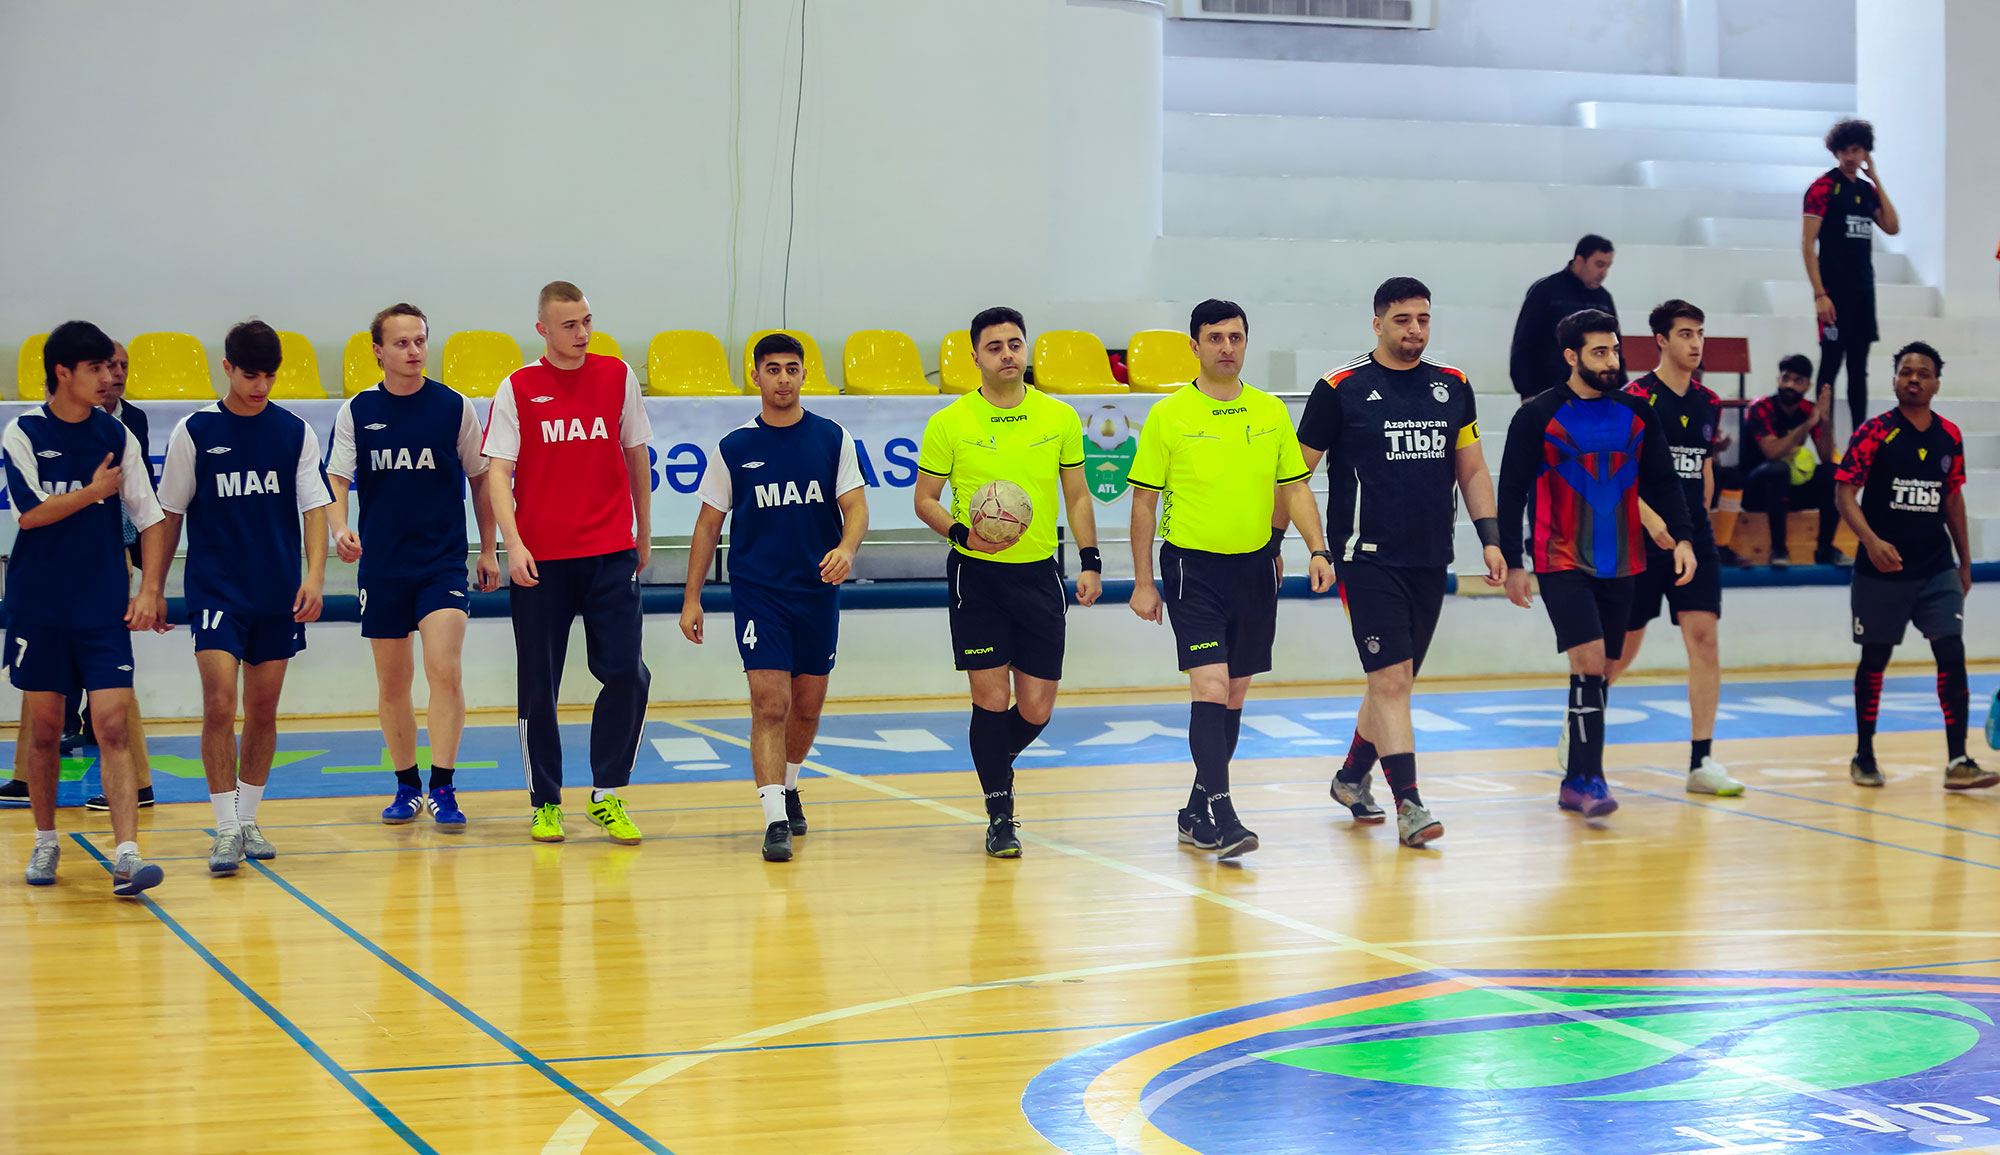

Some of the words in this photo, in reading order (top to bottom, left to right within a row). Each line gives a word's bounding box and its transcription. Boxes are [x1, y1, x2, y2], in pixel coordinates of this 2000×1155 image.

[990, 414, 1027, 423] GIVOVA
[1212, 407, 1247, 416] GIVOVA
[541, 416, 609, 443] MAA
[1384, 420, 1448, 430] Azərbaycan
[1384, 429, 1447, 452] Tibb
[370, 447, 436, 472] MAA
[216, 470, 281, 497] MAA
[754, 479, 825, 509] MAA
[1097, 483, 1118, 494] ATL
[1892, 485, 1941, 506] Tibb
[359, 588, 368, 616] 9
[742, 619, 758, 650] 4
[1854, 617, 1865, 635] 6
[15, 636, 28, 668] 7
